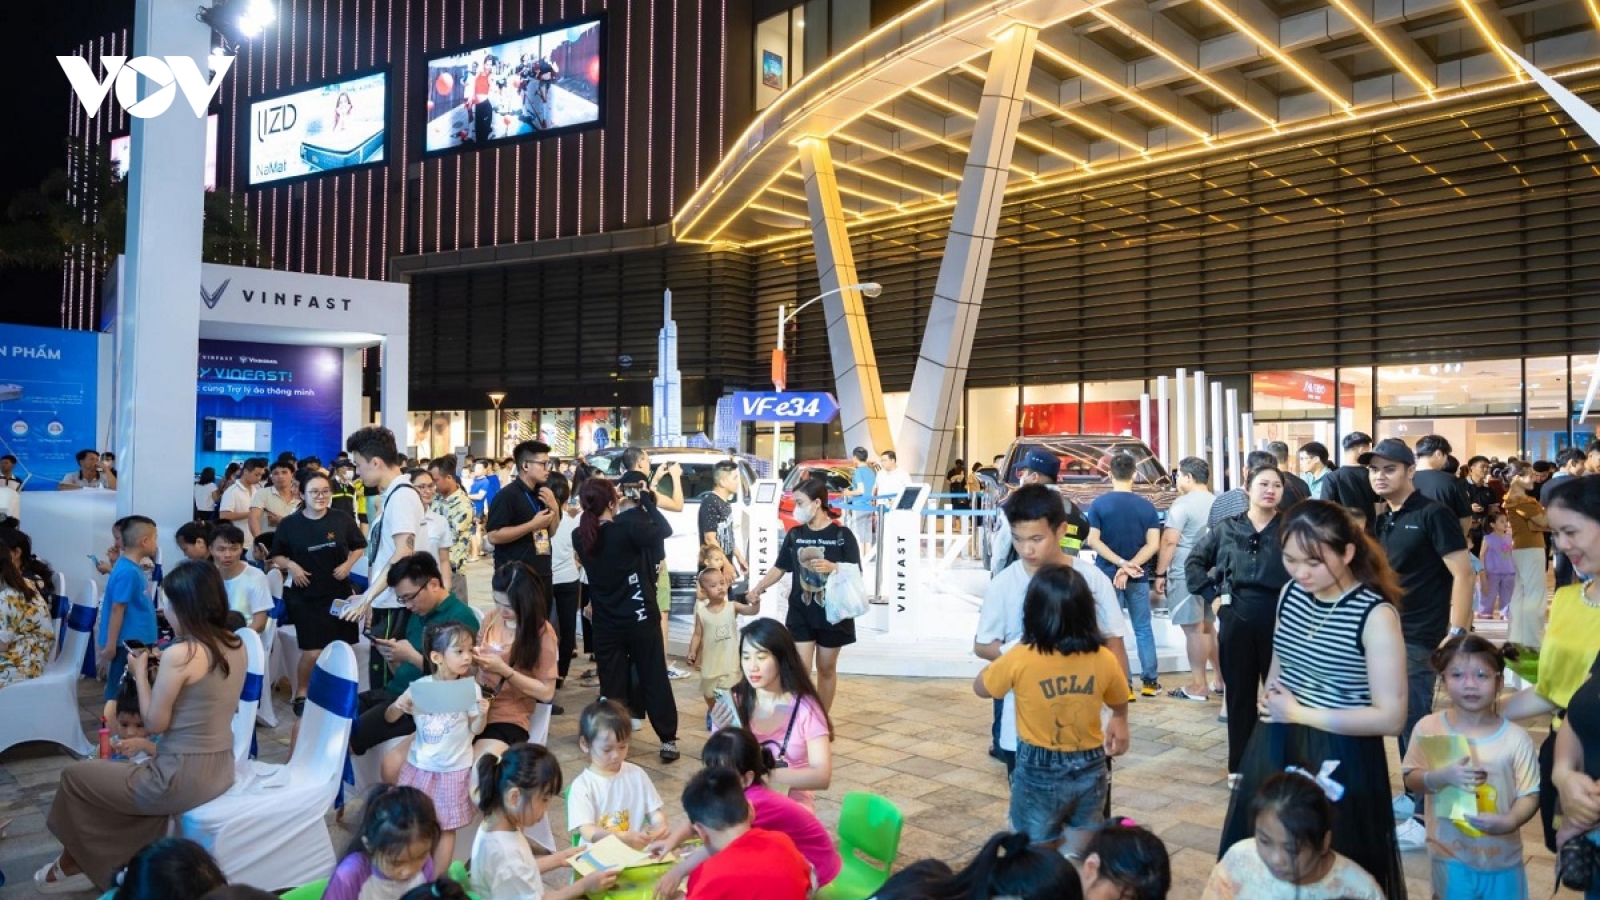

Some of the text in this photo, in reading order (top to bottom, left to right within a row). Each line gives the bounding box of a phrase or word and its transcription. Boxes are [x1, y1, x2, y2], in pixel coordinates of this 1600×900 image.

[242, 289, 351, 311] VINFAST
[266, 386, 292, 397] thông
[294, 387, 316, 397] minh
[758, 526, 768, 594] NFAST
[897, 535, 906, 613] VINFAST
[1039, 674, 1095, 699] UCLA
